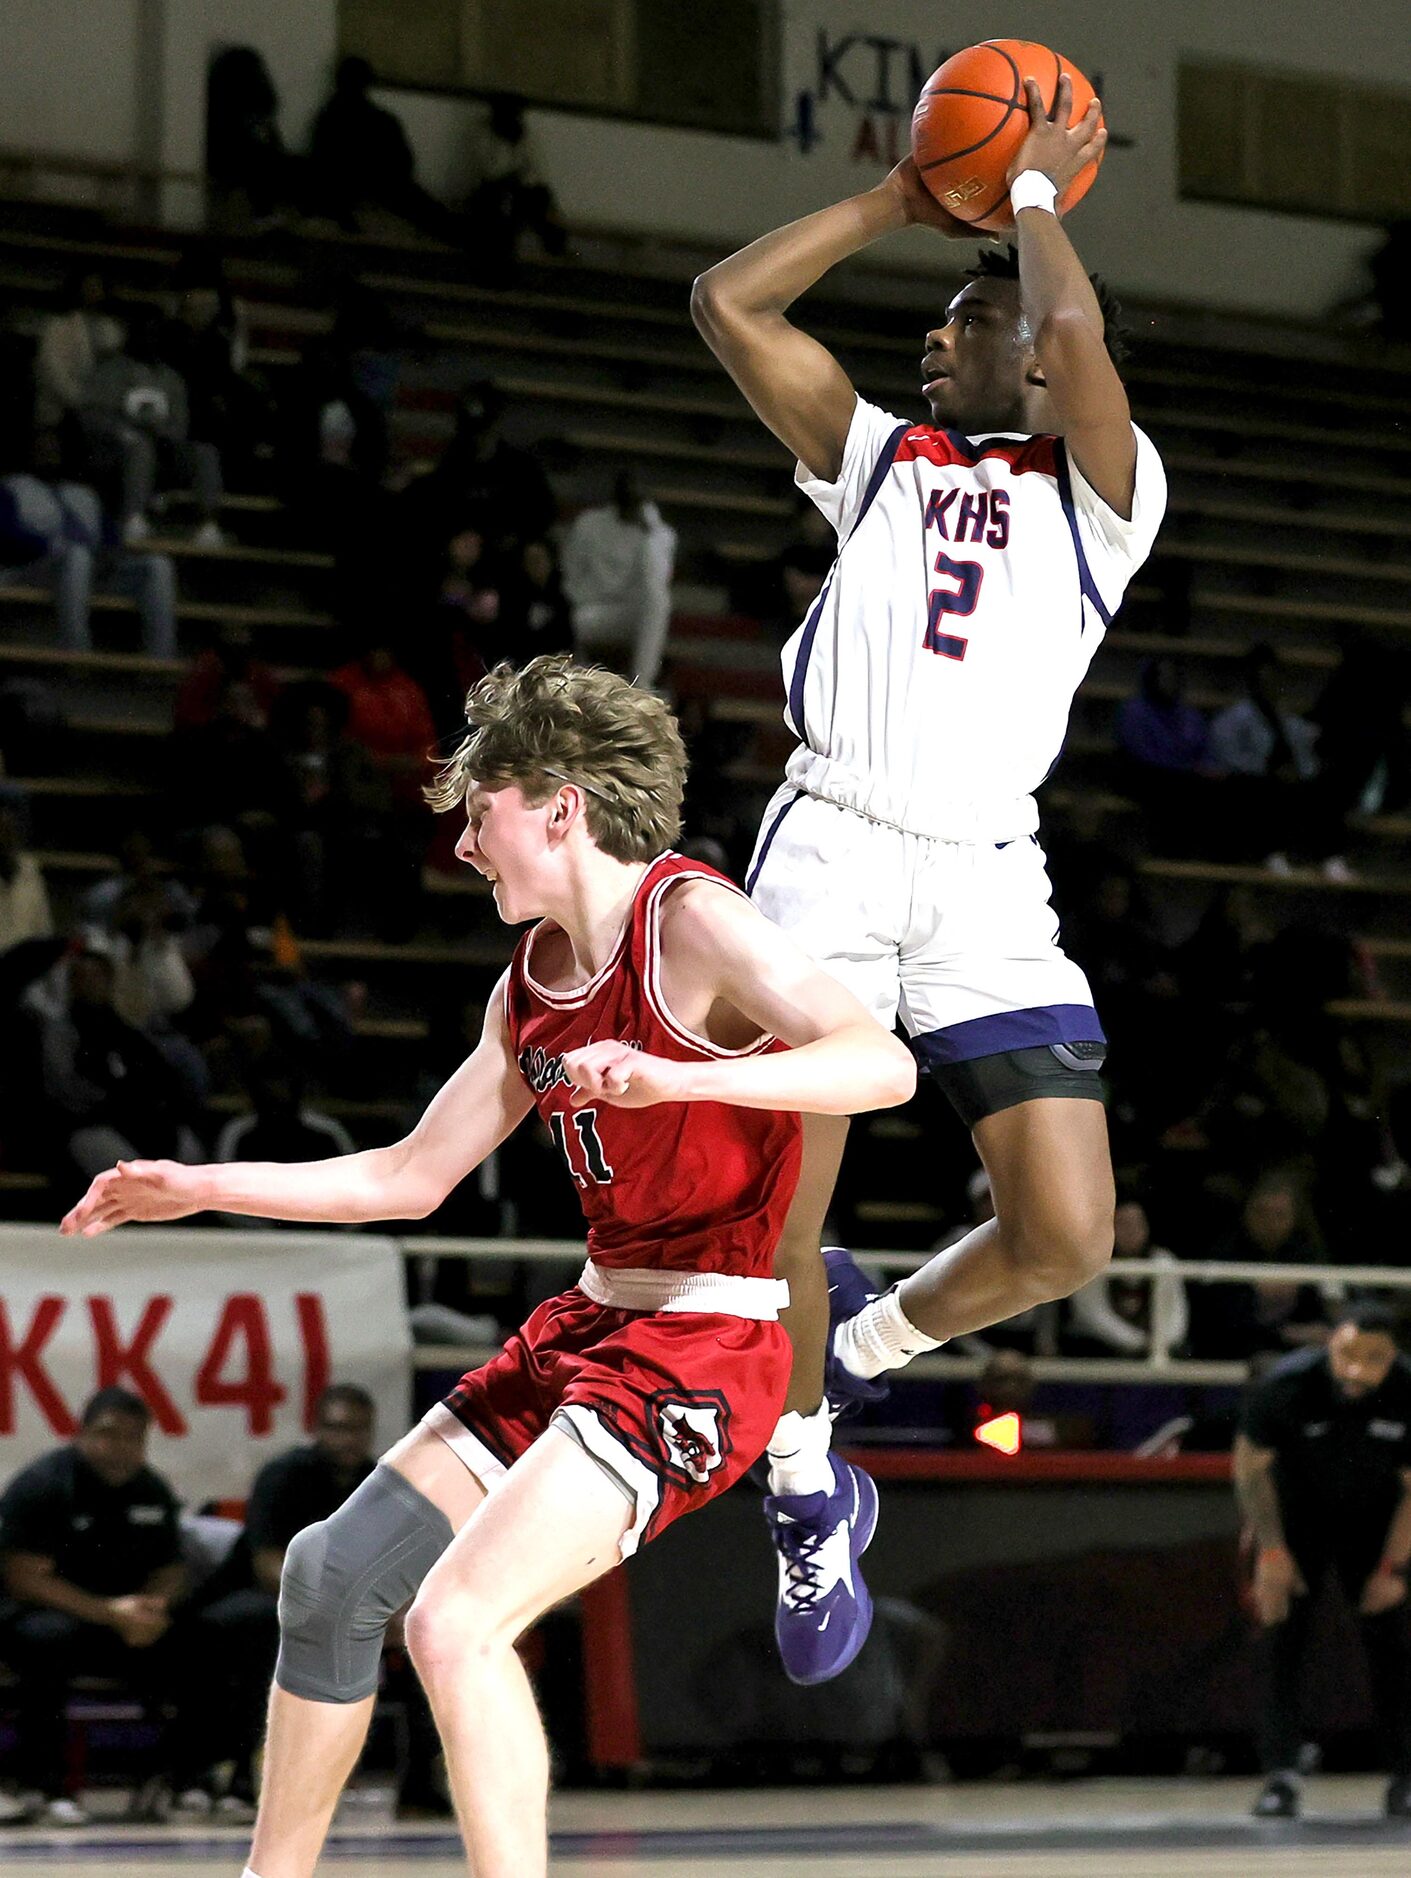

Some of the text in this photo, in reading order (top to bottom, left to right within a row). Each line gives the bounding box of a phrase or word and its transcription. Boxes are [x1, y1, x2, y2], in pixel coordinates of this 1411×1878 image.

[924, 488, 1011, 549] KHS
[922, 551, 984, 661] 2
[548, 1108, 614, 1188] 11
